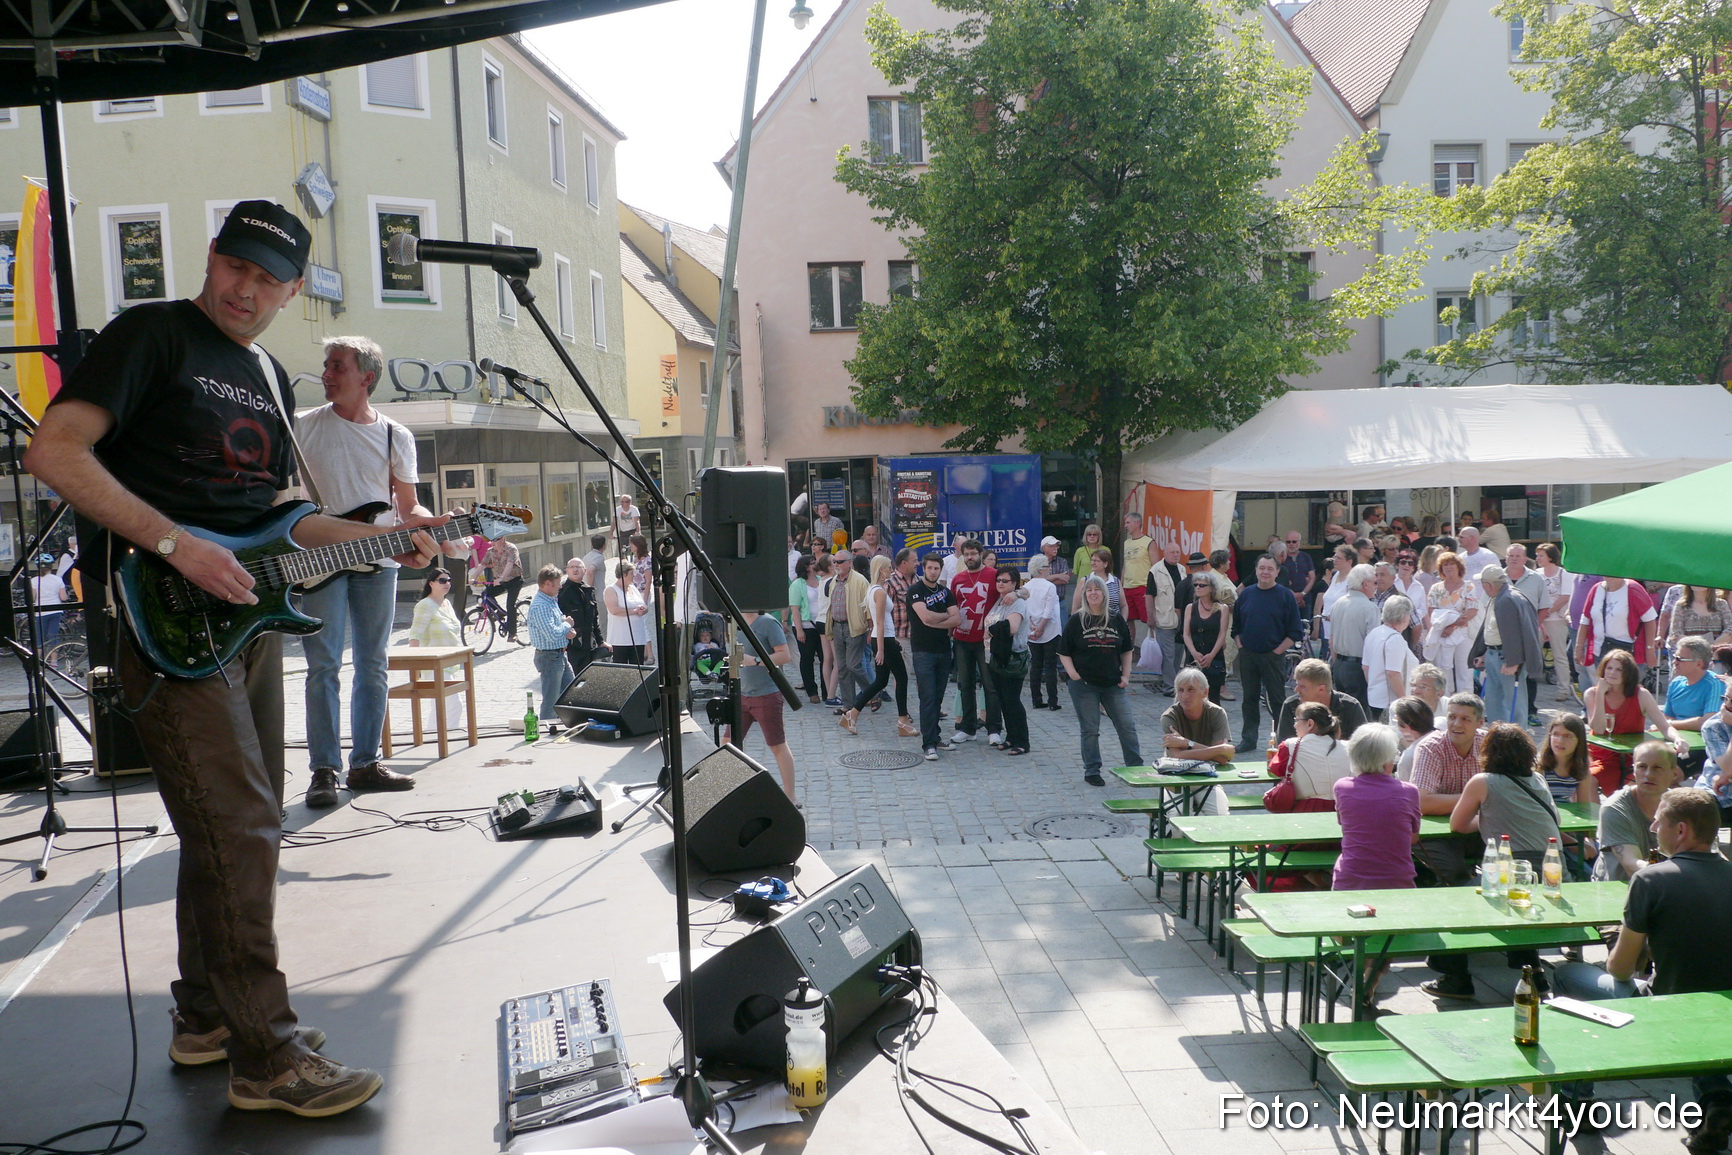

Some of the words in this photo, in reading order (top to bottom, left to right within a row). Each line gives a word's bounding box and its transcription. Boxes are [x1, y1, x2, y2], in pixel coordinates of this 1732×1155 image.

[298, 78, 330, 113] Rodenstock
[309, 181, 334, 202] Schweiger
[250, 219, 297, 246] DIADORA
[387, 225, 412, 234] Optiker
[127, 237, 154, 246] Optiker
[123, 257, 161, 267] Schweiger
[133, 277, 156, 286] Brillen
[316, 267, 337, 284] Uhren
[392, 272, 412, 280] linsen
[661, 360, 676, 411] Nudeltreff
[1181, 521, 1203, 555] bar
